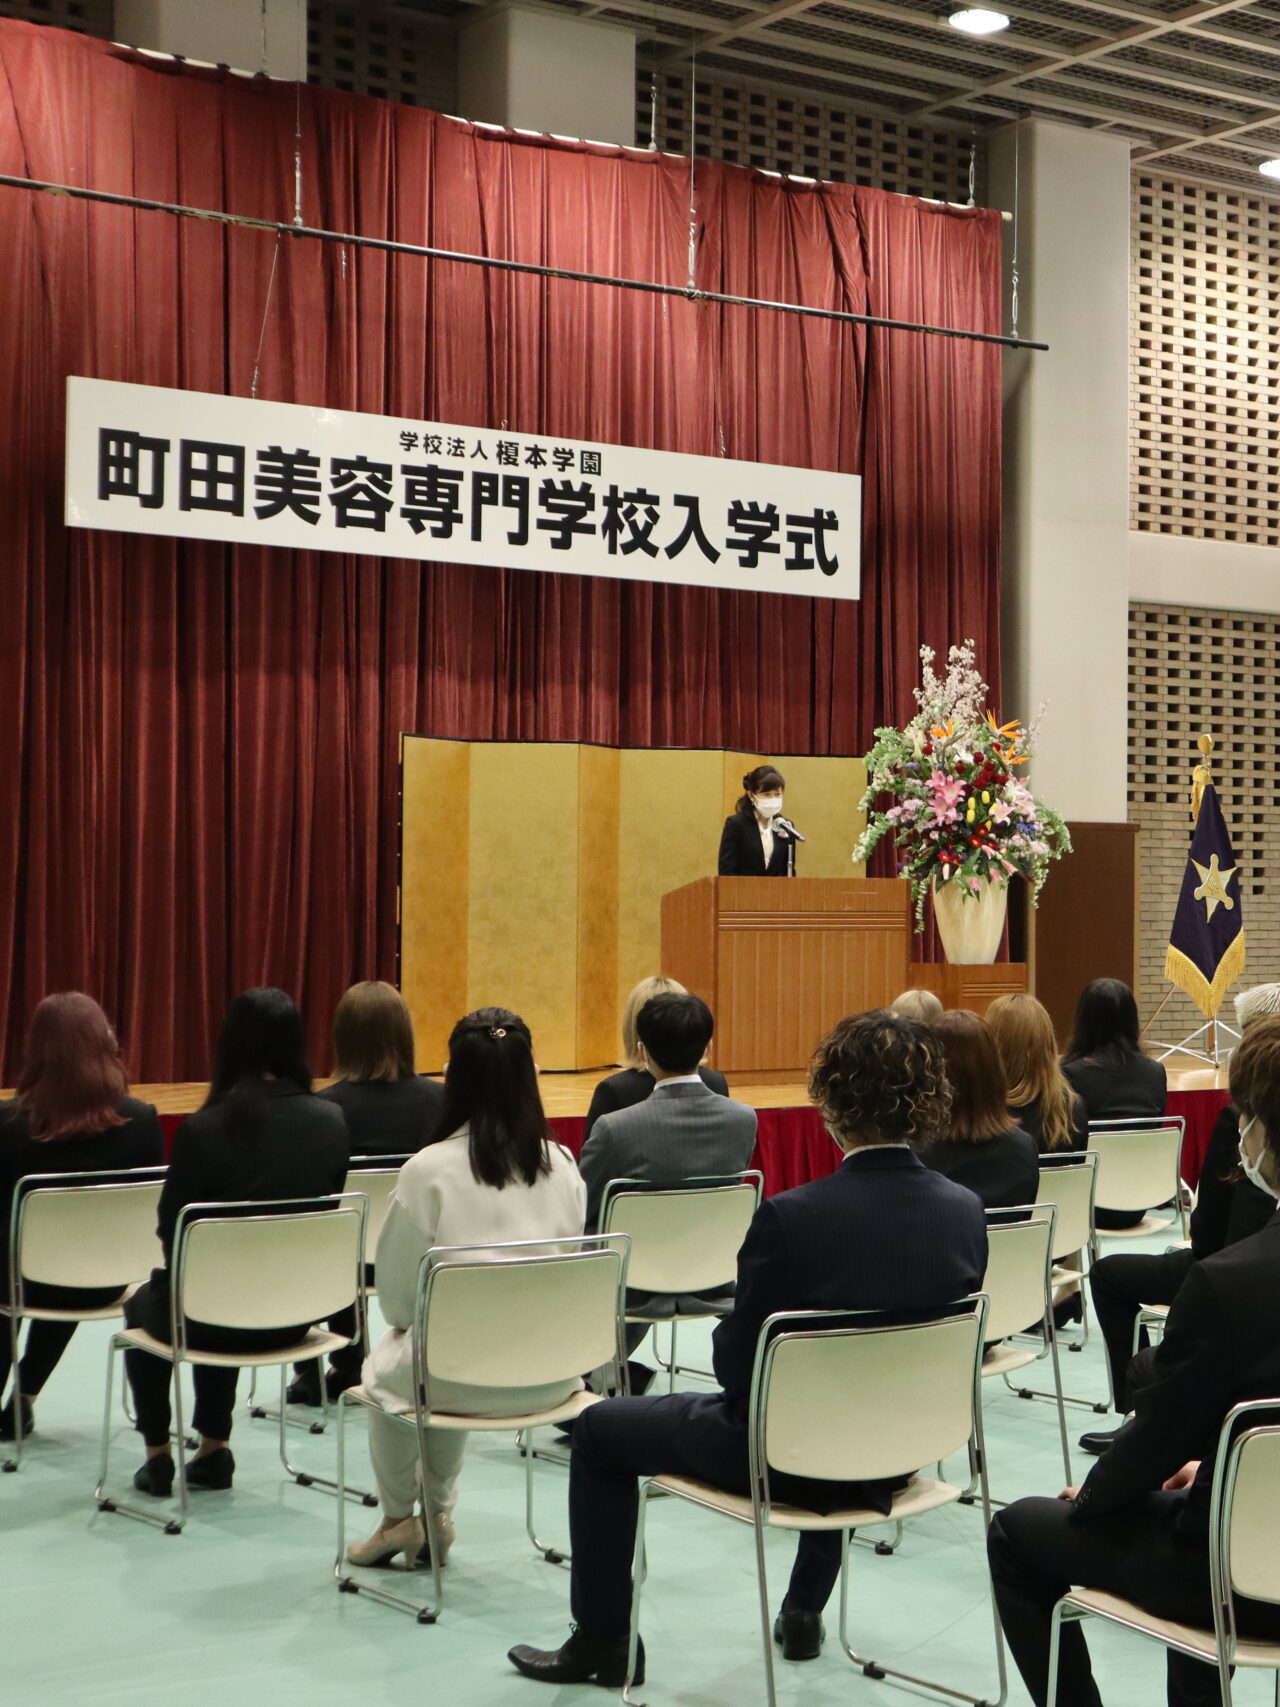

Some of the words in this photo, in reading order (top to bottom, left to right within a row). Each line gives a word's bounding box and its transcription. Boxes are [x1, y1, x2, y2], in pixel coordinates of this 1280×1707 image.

[98, 427, 839, 577] 町田美容専門学校入学式
